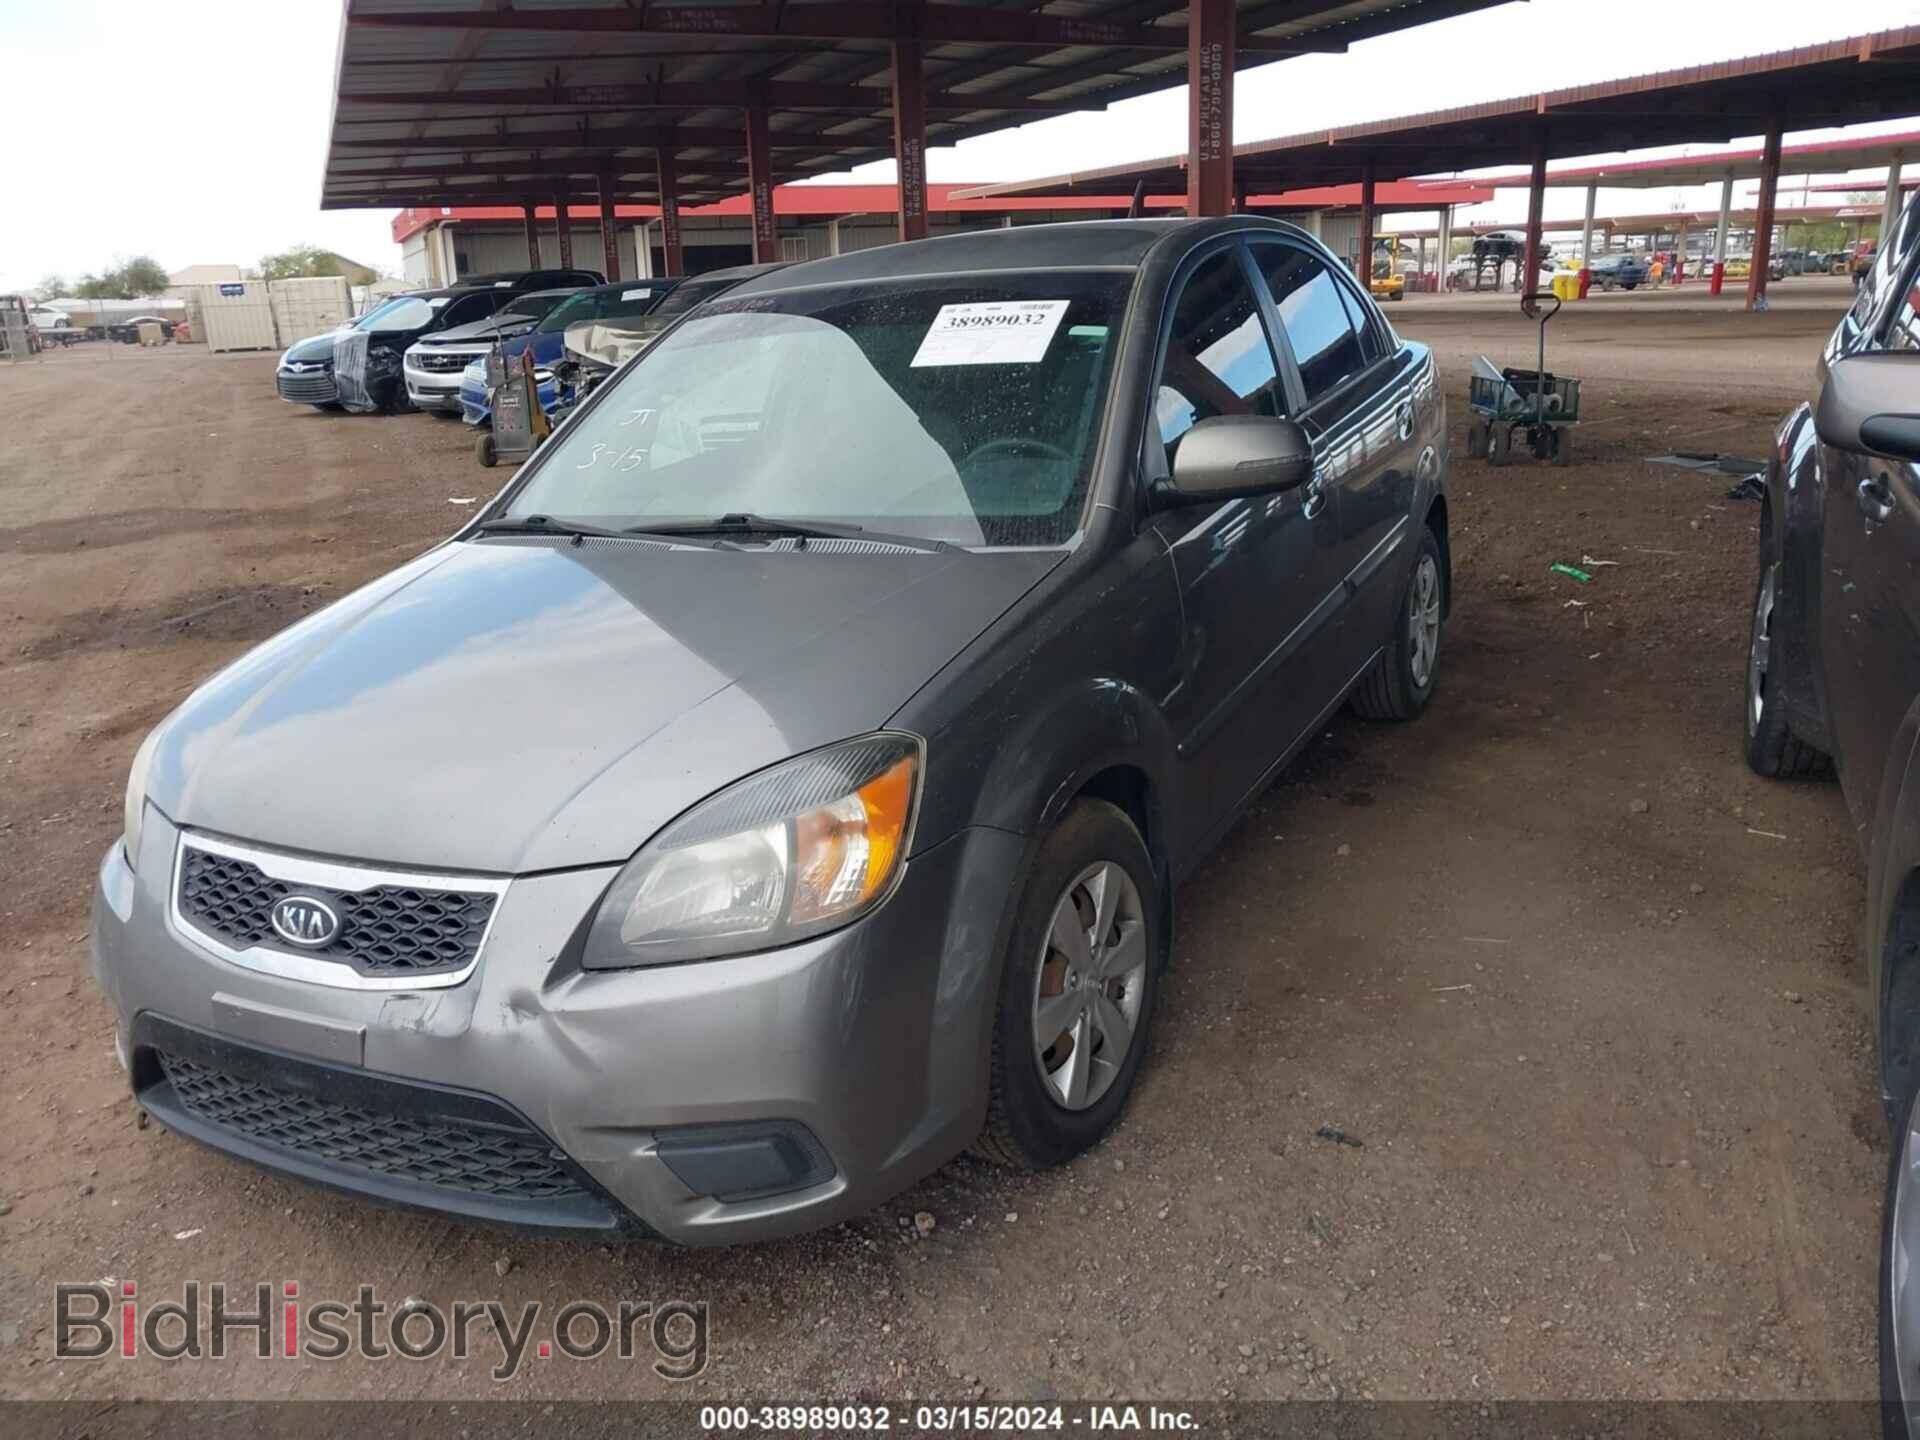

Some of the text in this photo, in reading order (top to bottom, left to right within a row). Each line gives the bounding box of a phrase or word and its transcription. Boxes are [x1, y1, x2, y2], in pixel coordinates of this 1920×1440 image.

[944, 313, 1046, 329] 38989032
[576, 443, 649, 472] 3-15
[282, 906, 325, 938] KIA
